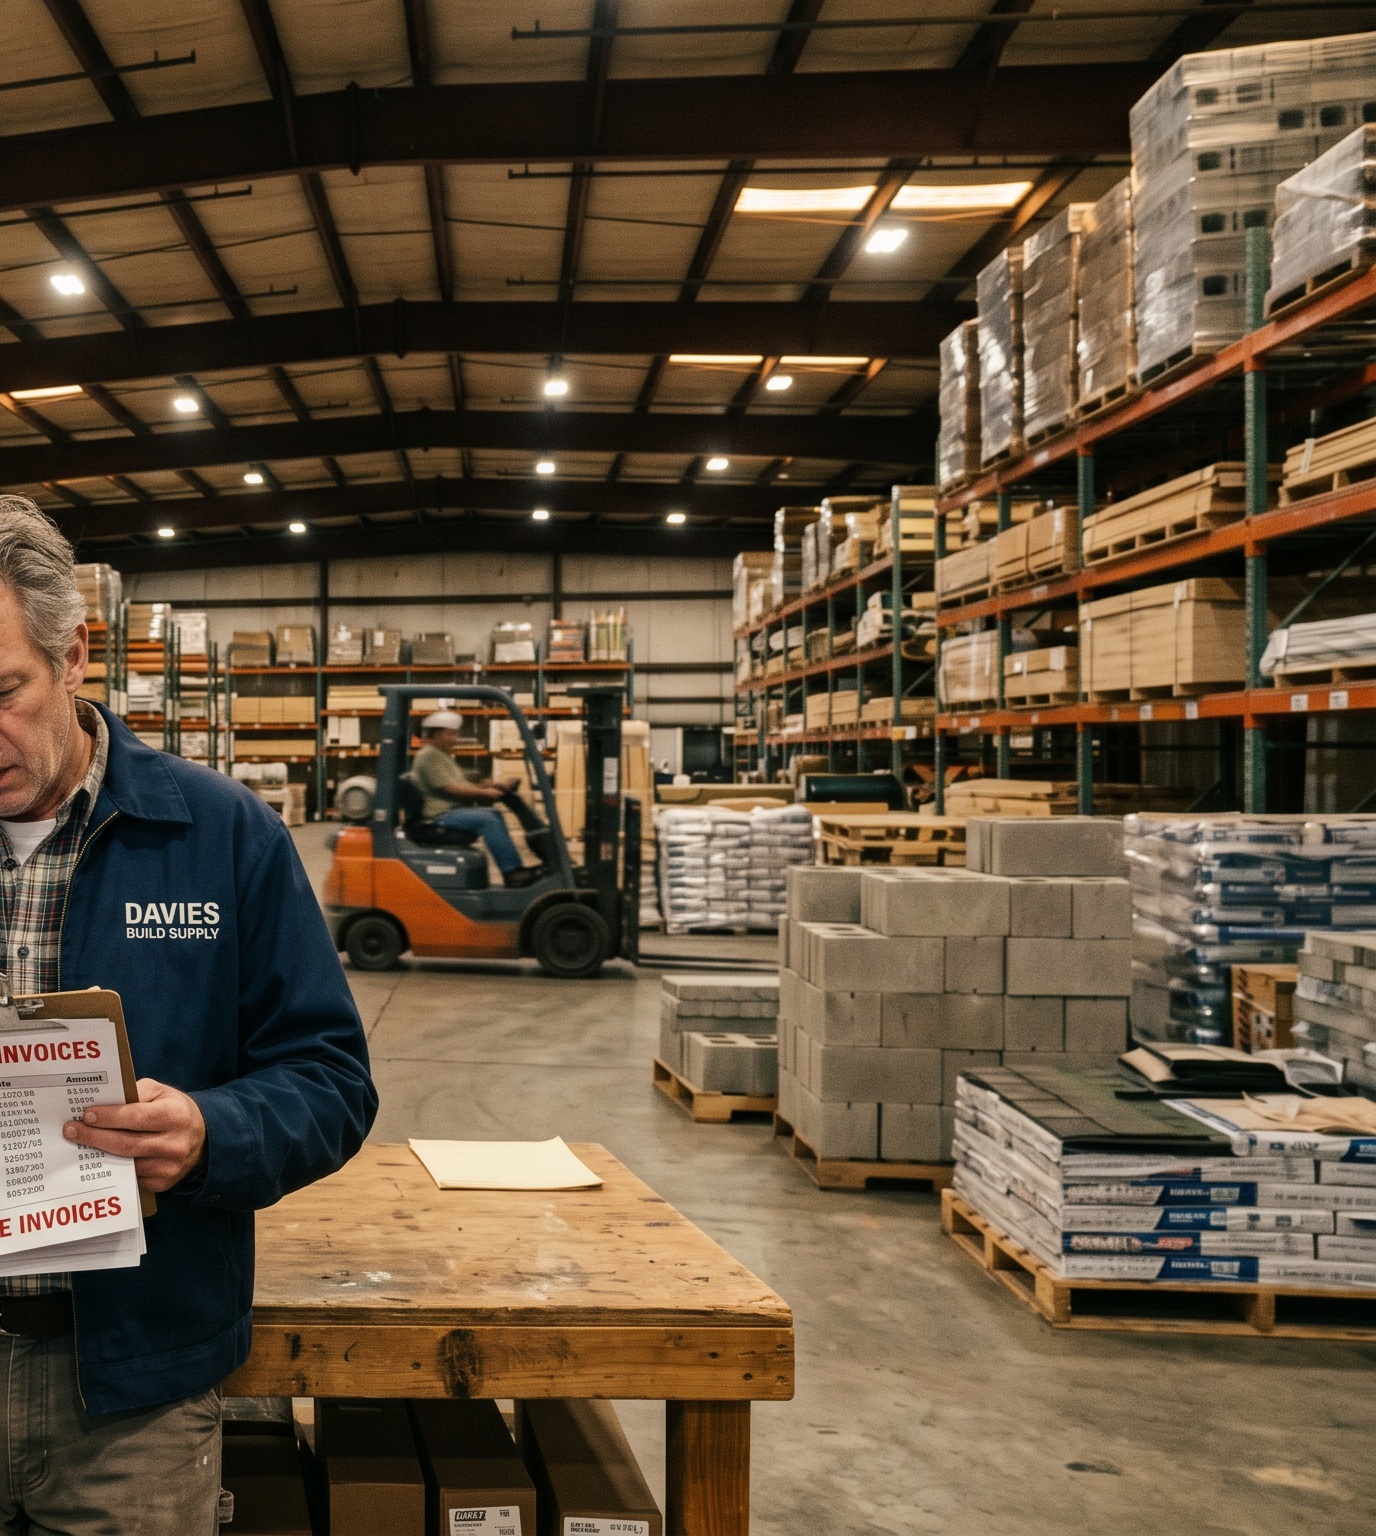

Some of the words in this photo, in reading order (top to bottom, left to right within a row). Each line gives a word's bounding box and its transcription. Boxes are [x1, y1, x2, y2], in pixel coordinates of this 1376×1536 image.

[125, 902, 220, 925] DAVIES
[126, 927, 166, 939] BUILD
[169, 927, 220, 940] SUPPLY
[19, 1195, 122, 1234] INVOICES
